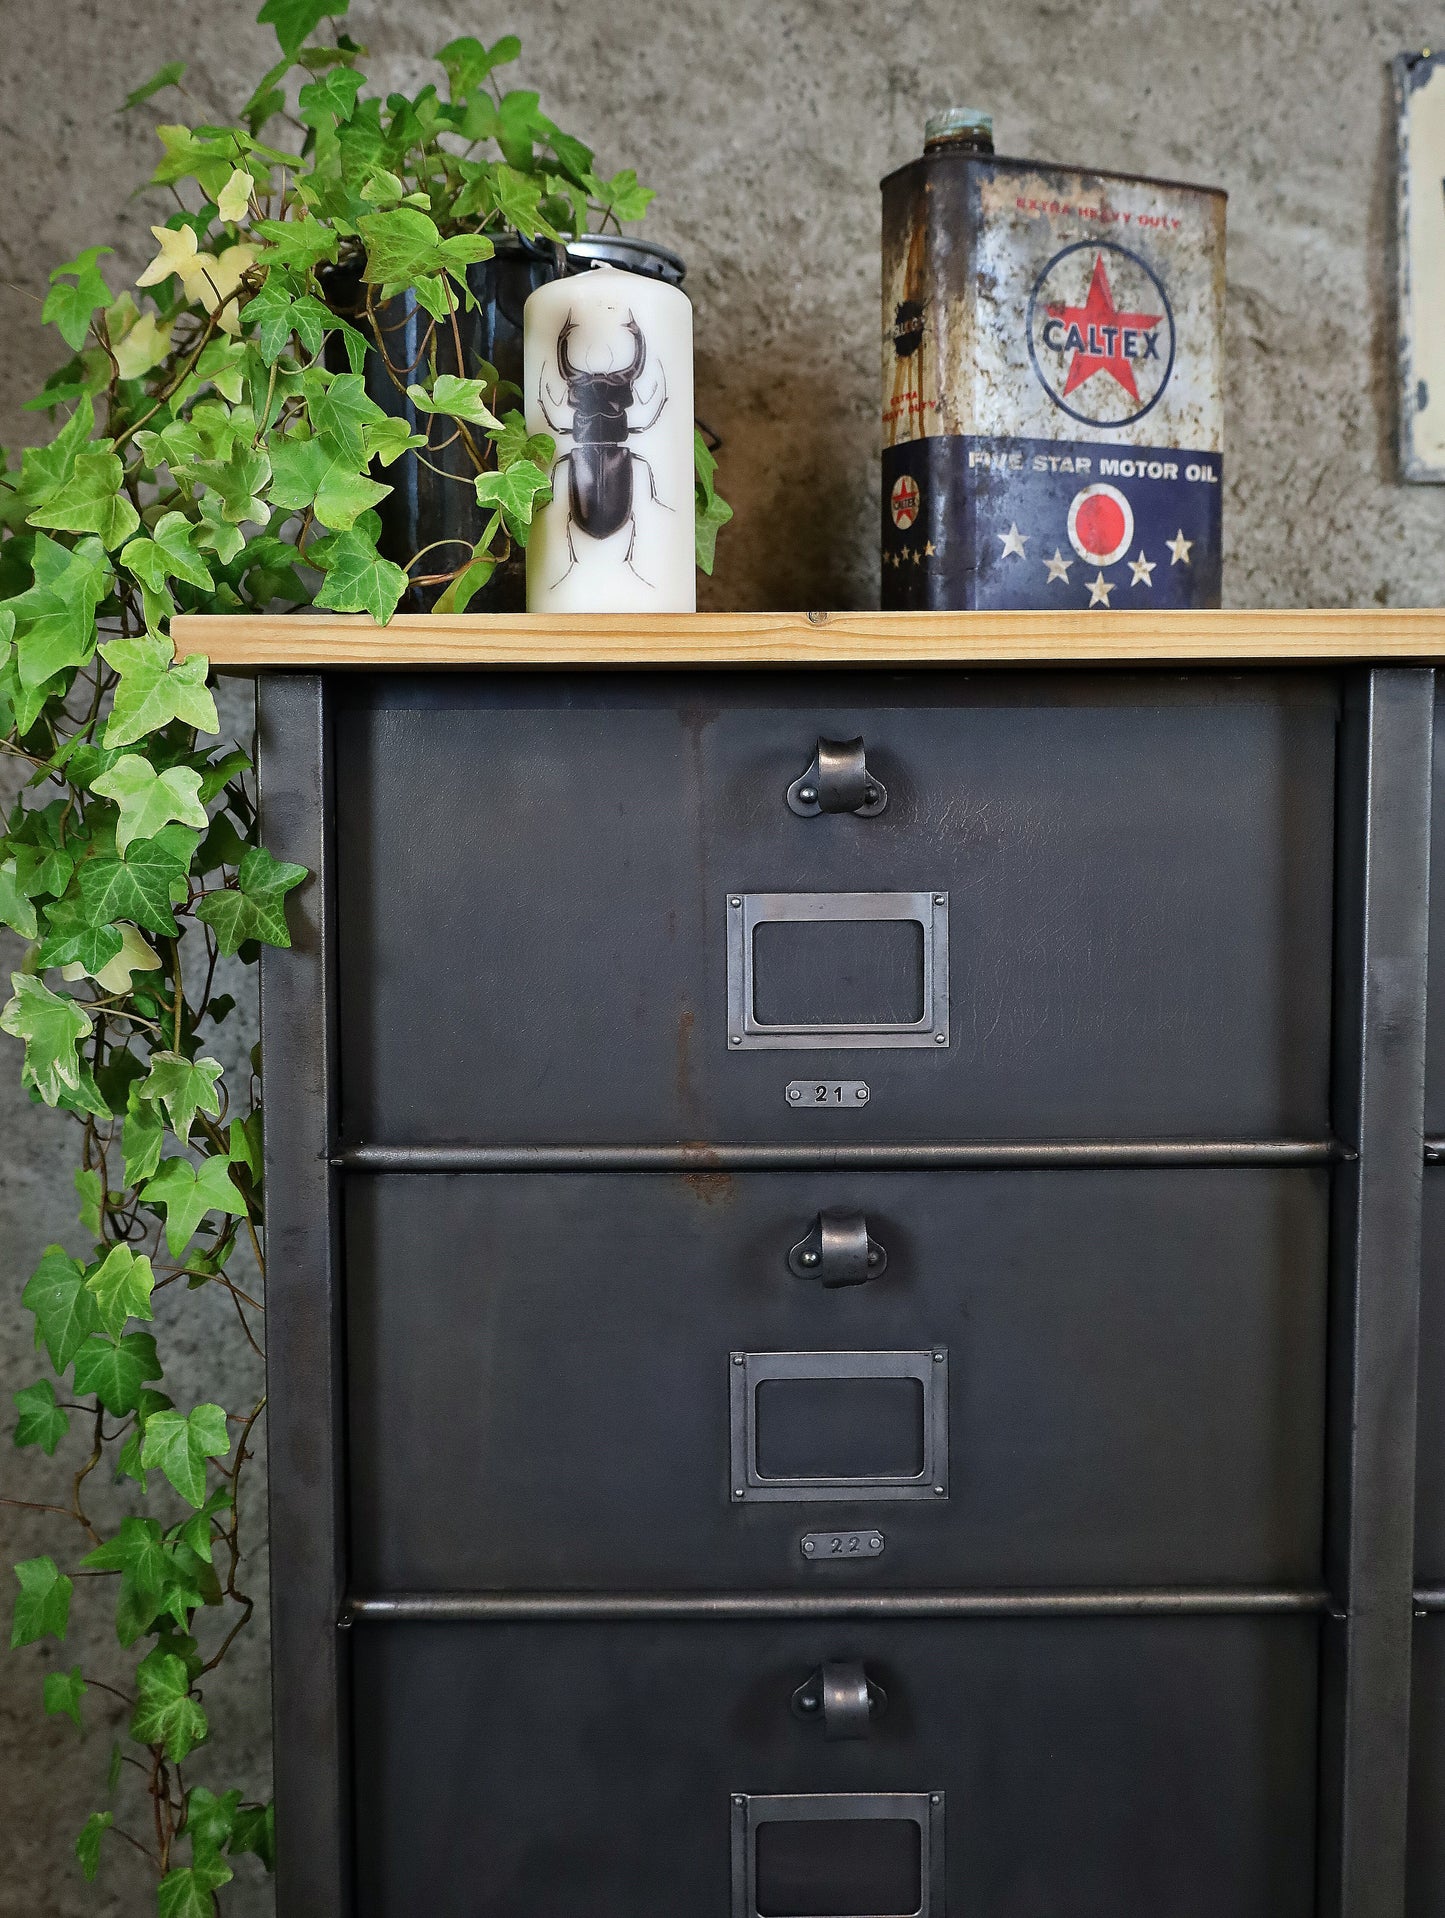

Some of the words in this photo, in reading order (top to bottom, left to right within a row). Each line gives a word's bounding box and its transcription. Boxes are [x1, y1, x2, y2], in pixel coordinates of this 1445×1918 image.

[1042, 319, 1160, 360] CALTEX
[968, 451, 1024, 471] FIVE
[1031, 454, 1092, 474] STAR
[1100, 458, 1179, 480] MOTOR
[1185, 463, 1218, 483] OIL
[815, 1085, 843, 1102] 21
[831, 1537, 860, 1554] 22
